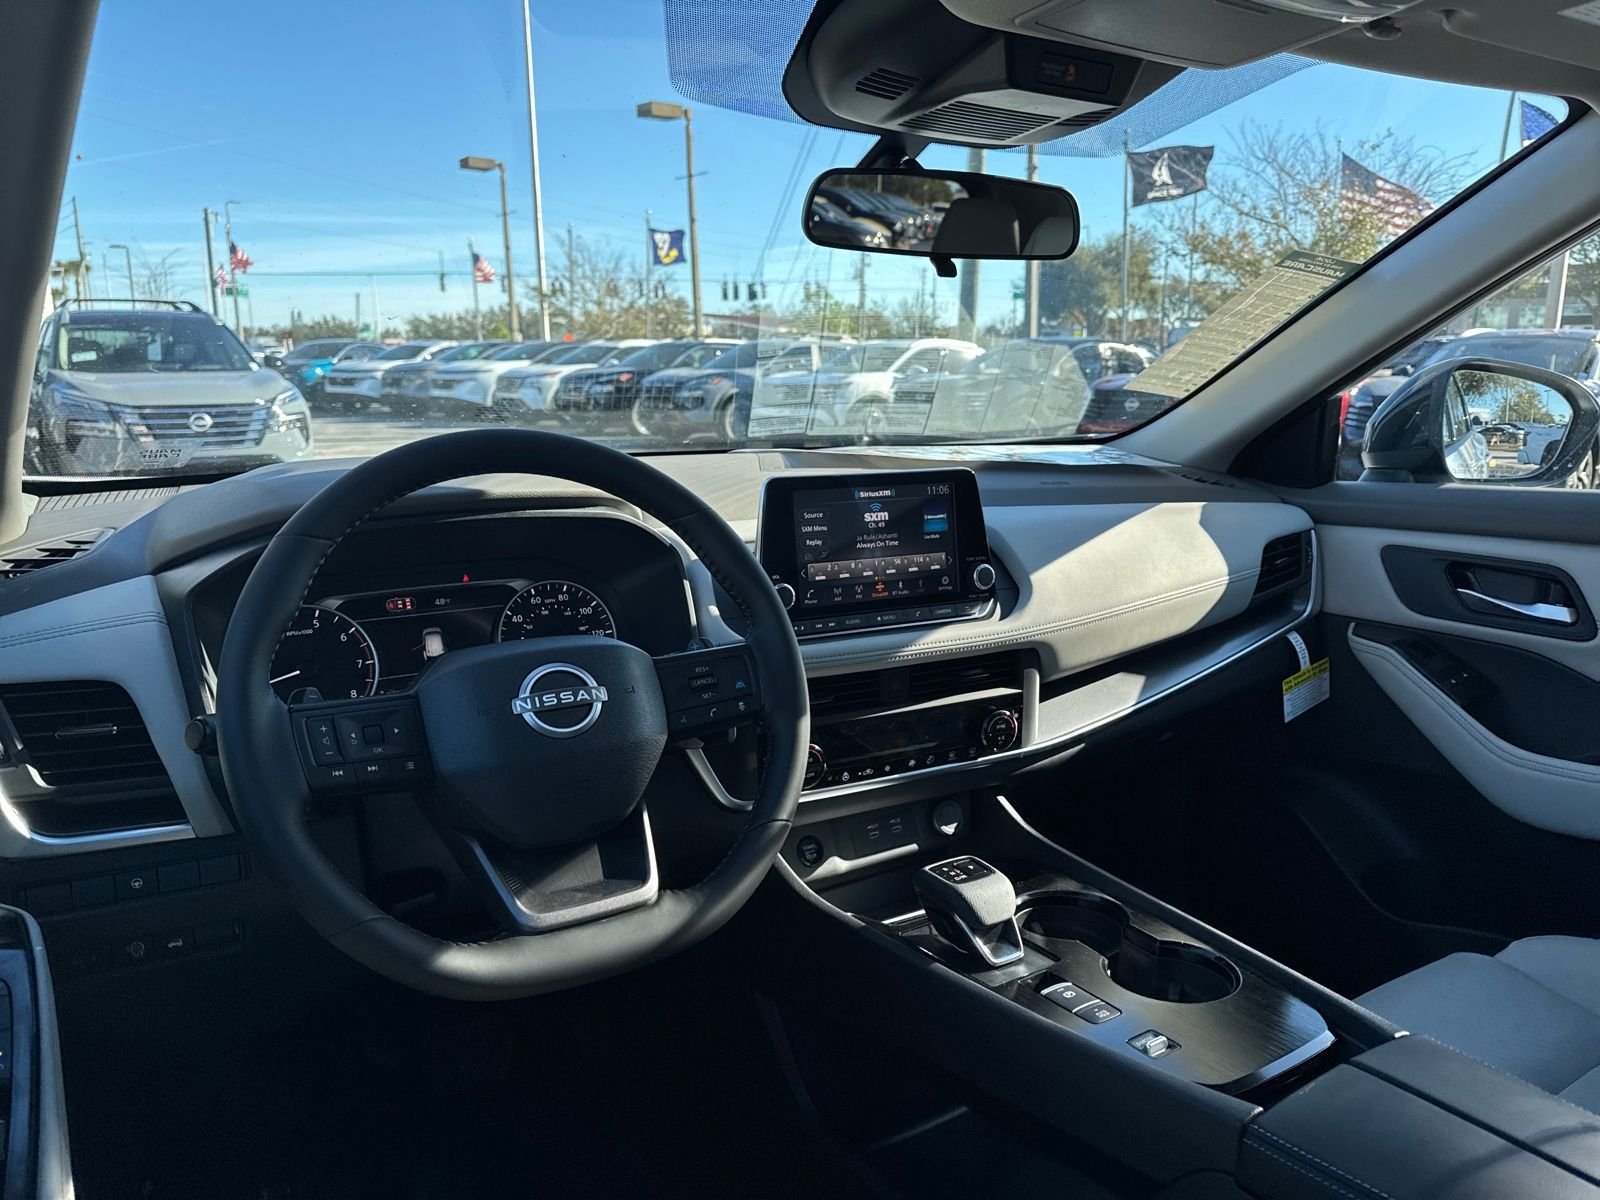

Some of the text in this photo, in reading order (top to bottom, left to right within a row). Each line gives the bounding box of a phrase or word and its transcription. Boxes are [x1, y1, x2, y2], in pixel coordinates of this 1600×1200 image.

[927, 485, 950, 495] 11:06
[530, 596, 541, 604] 60
[580, 607, 592, 615] 100
[512, 614, 523, 622] 40
[312, 620, 320, 628] 5
[340, 632, 348, 642] 6
[356, 660, 362, 668] 7
[350, 689, 358, 698] 8
[514, 688, 606, 712] NISSAN
